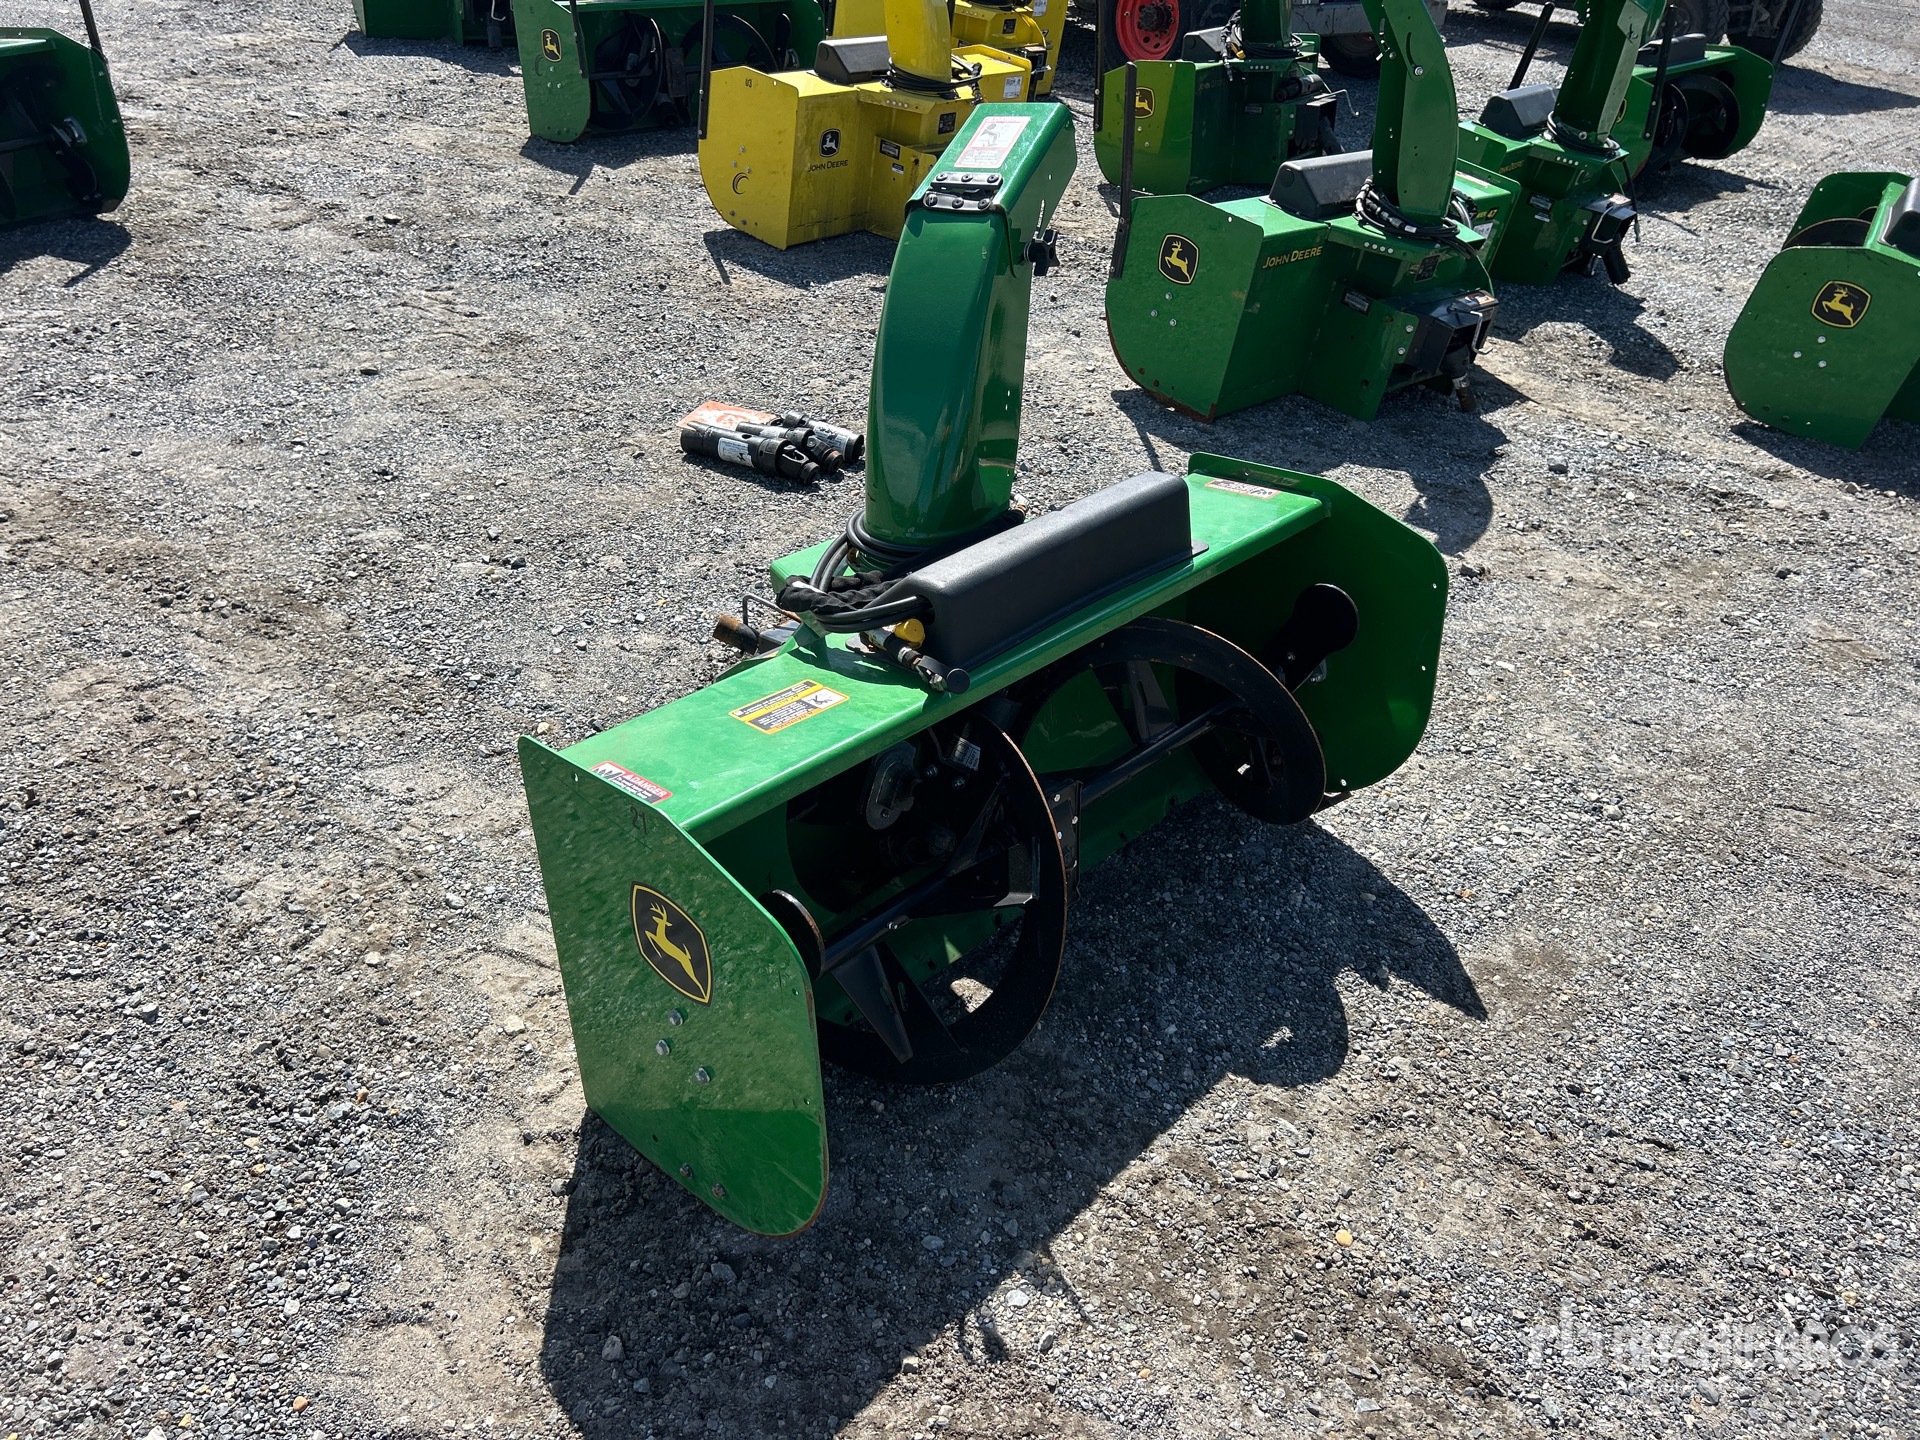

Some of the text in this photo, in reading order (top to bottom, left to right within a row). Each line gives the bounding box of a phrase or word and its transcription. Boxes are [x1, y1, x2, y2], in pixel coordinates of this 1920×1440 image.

[807, 160, 849, 173] JOHN DEERE
[1262, 246, 1324, 269] JOHN DEERE
[632, 776, 669, 798] DANGER
